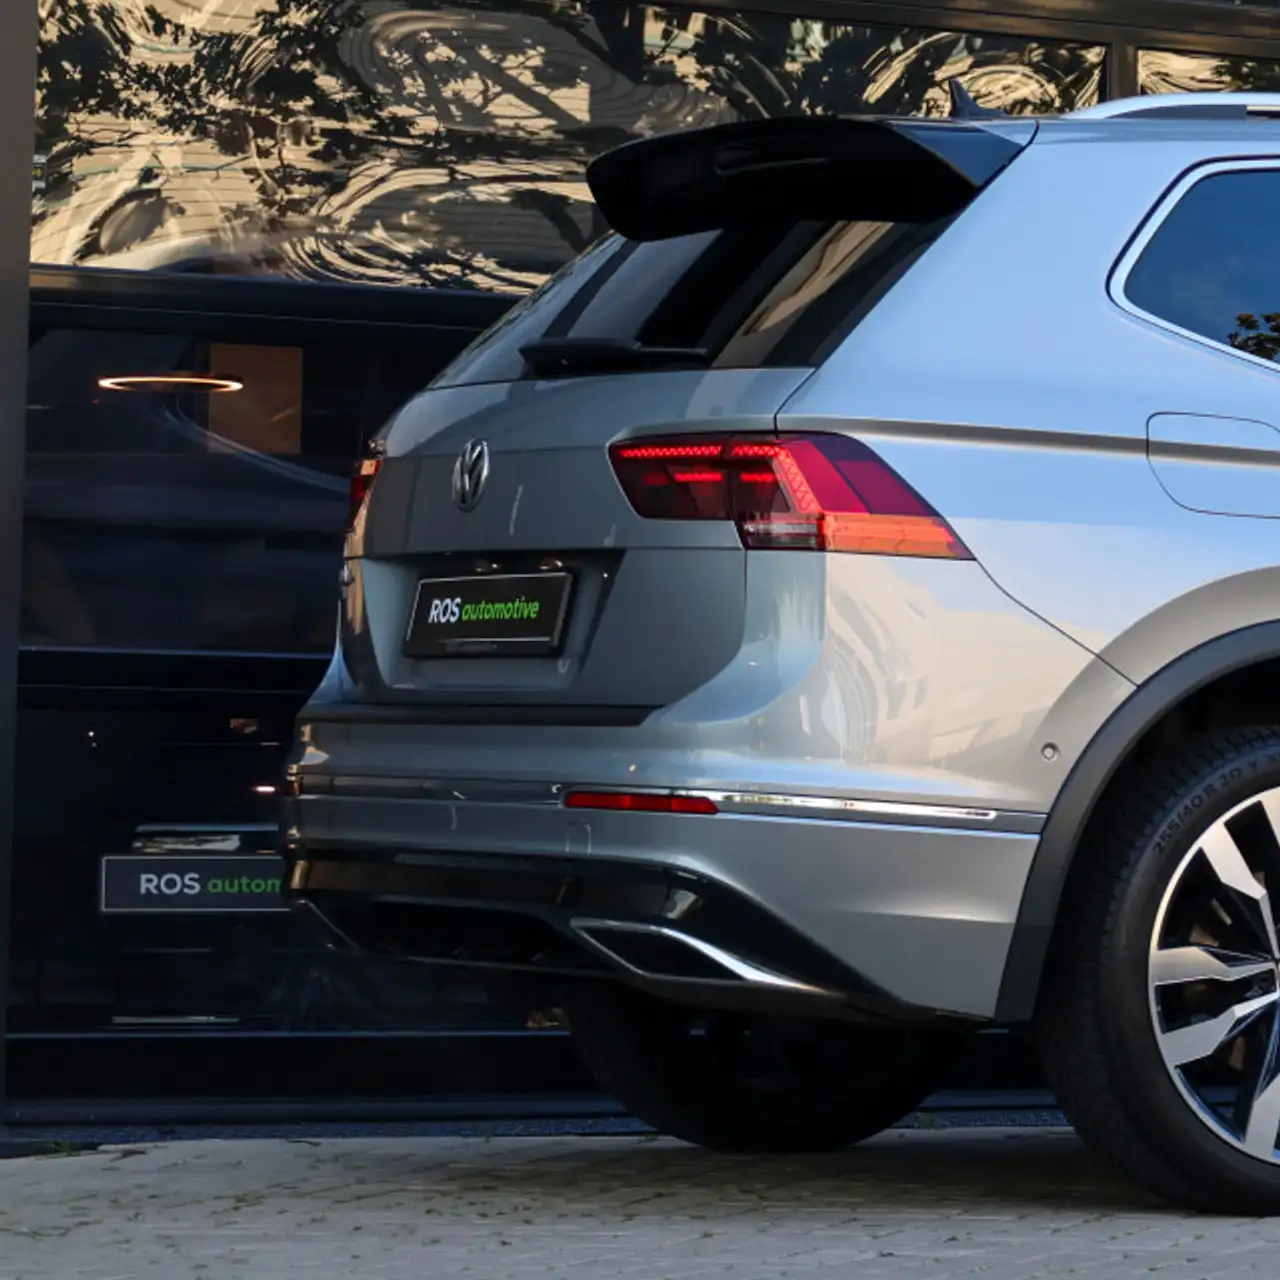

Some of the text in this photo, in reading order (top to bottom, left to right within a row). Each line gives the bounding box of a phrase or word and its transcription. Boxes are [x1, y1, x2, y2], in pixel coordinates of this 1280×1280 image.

[428, 596, 540, 624] ROS automotive
[1152, 794, 1204, 854] 255/40
[139, 873, 201, 895] ROS
